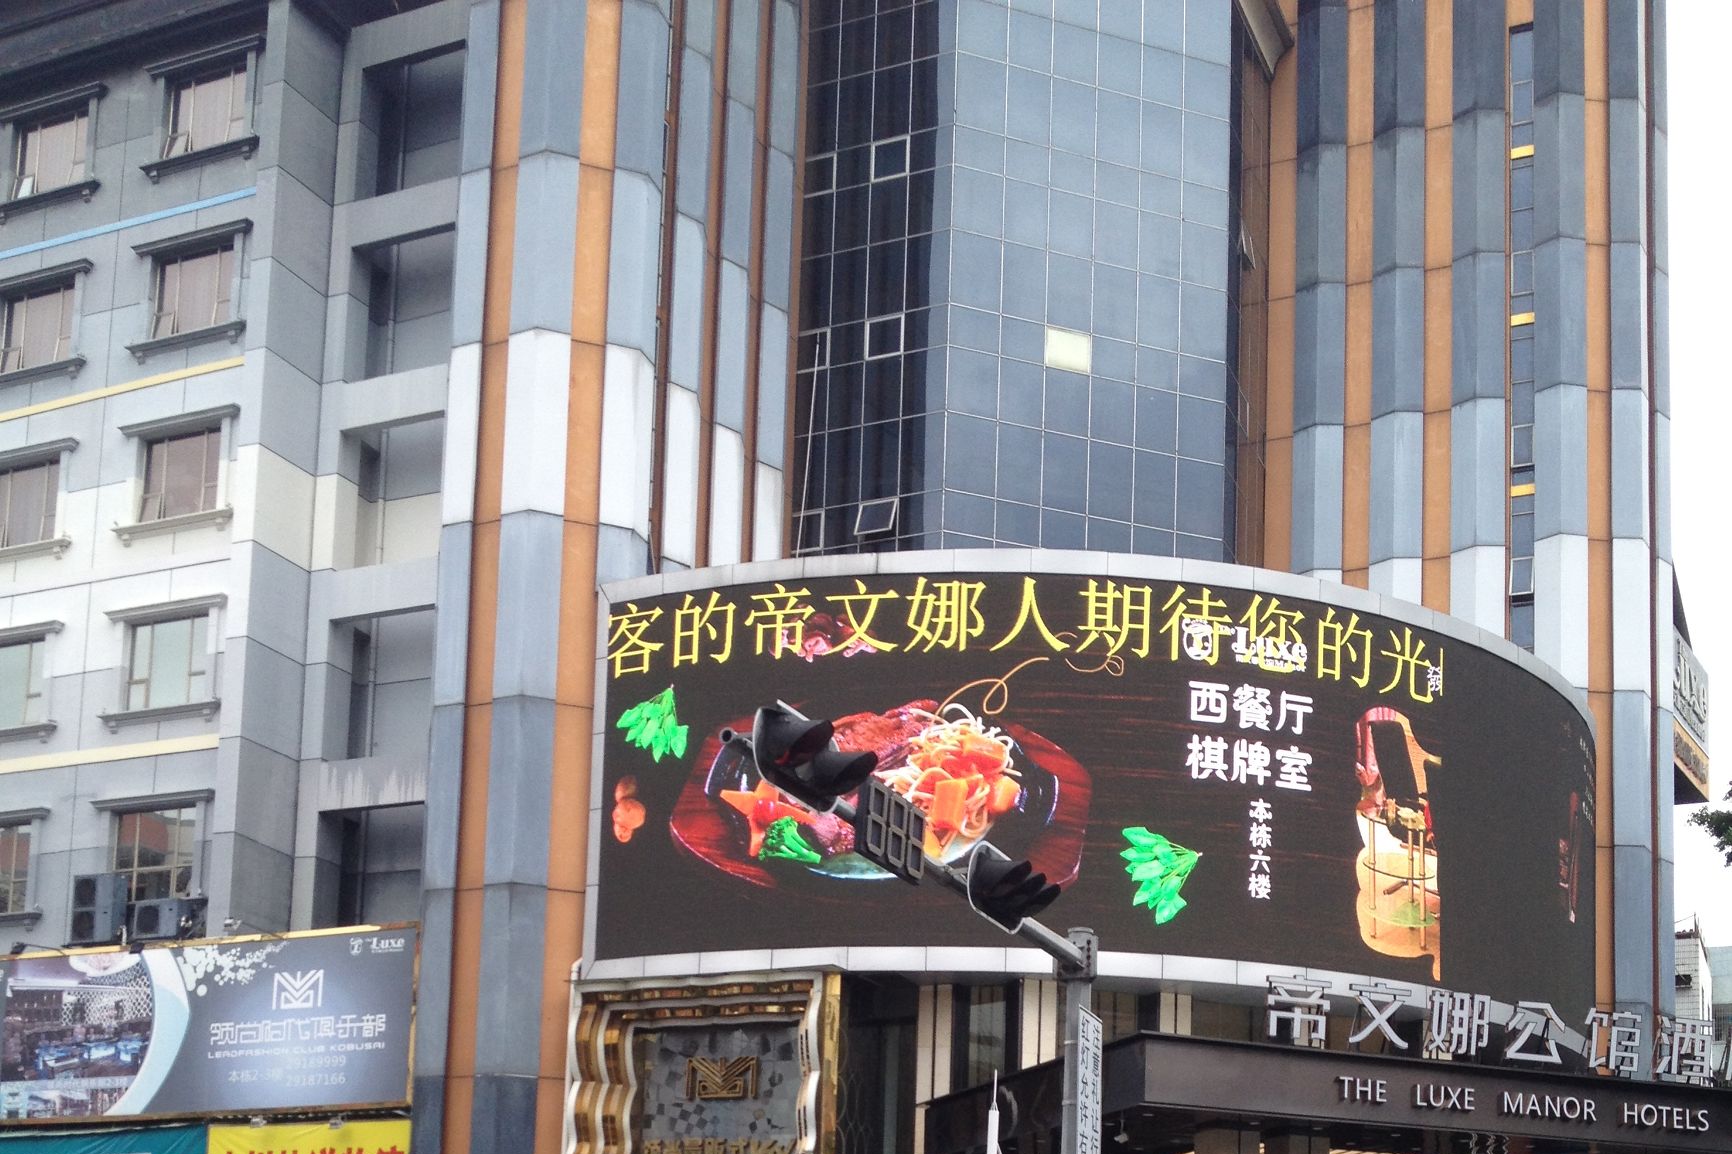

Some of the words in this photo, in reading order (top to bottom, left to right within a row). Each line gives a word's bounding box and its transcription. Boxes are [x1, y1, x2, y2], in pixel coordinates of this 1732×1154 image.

[607, 577, 1444, 703] 客的帝文娜人期待您的光
[1188, 680, 1314, 735] 西餐厅
[1185, 733, 1313, 792] 棋牌室
[1248, 798, 1273, 900] 本栋六楼
[1266, 974, 1732, 1083] 帝文娜公馆酒
[1339, 1076, 1388, 1104] THE
[1416, 1083, 1476, 1112] LUXE
[1503, 1091, 1597, 1123] MANOR
[1623, 1102, 1710, 1133] HOTELS
